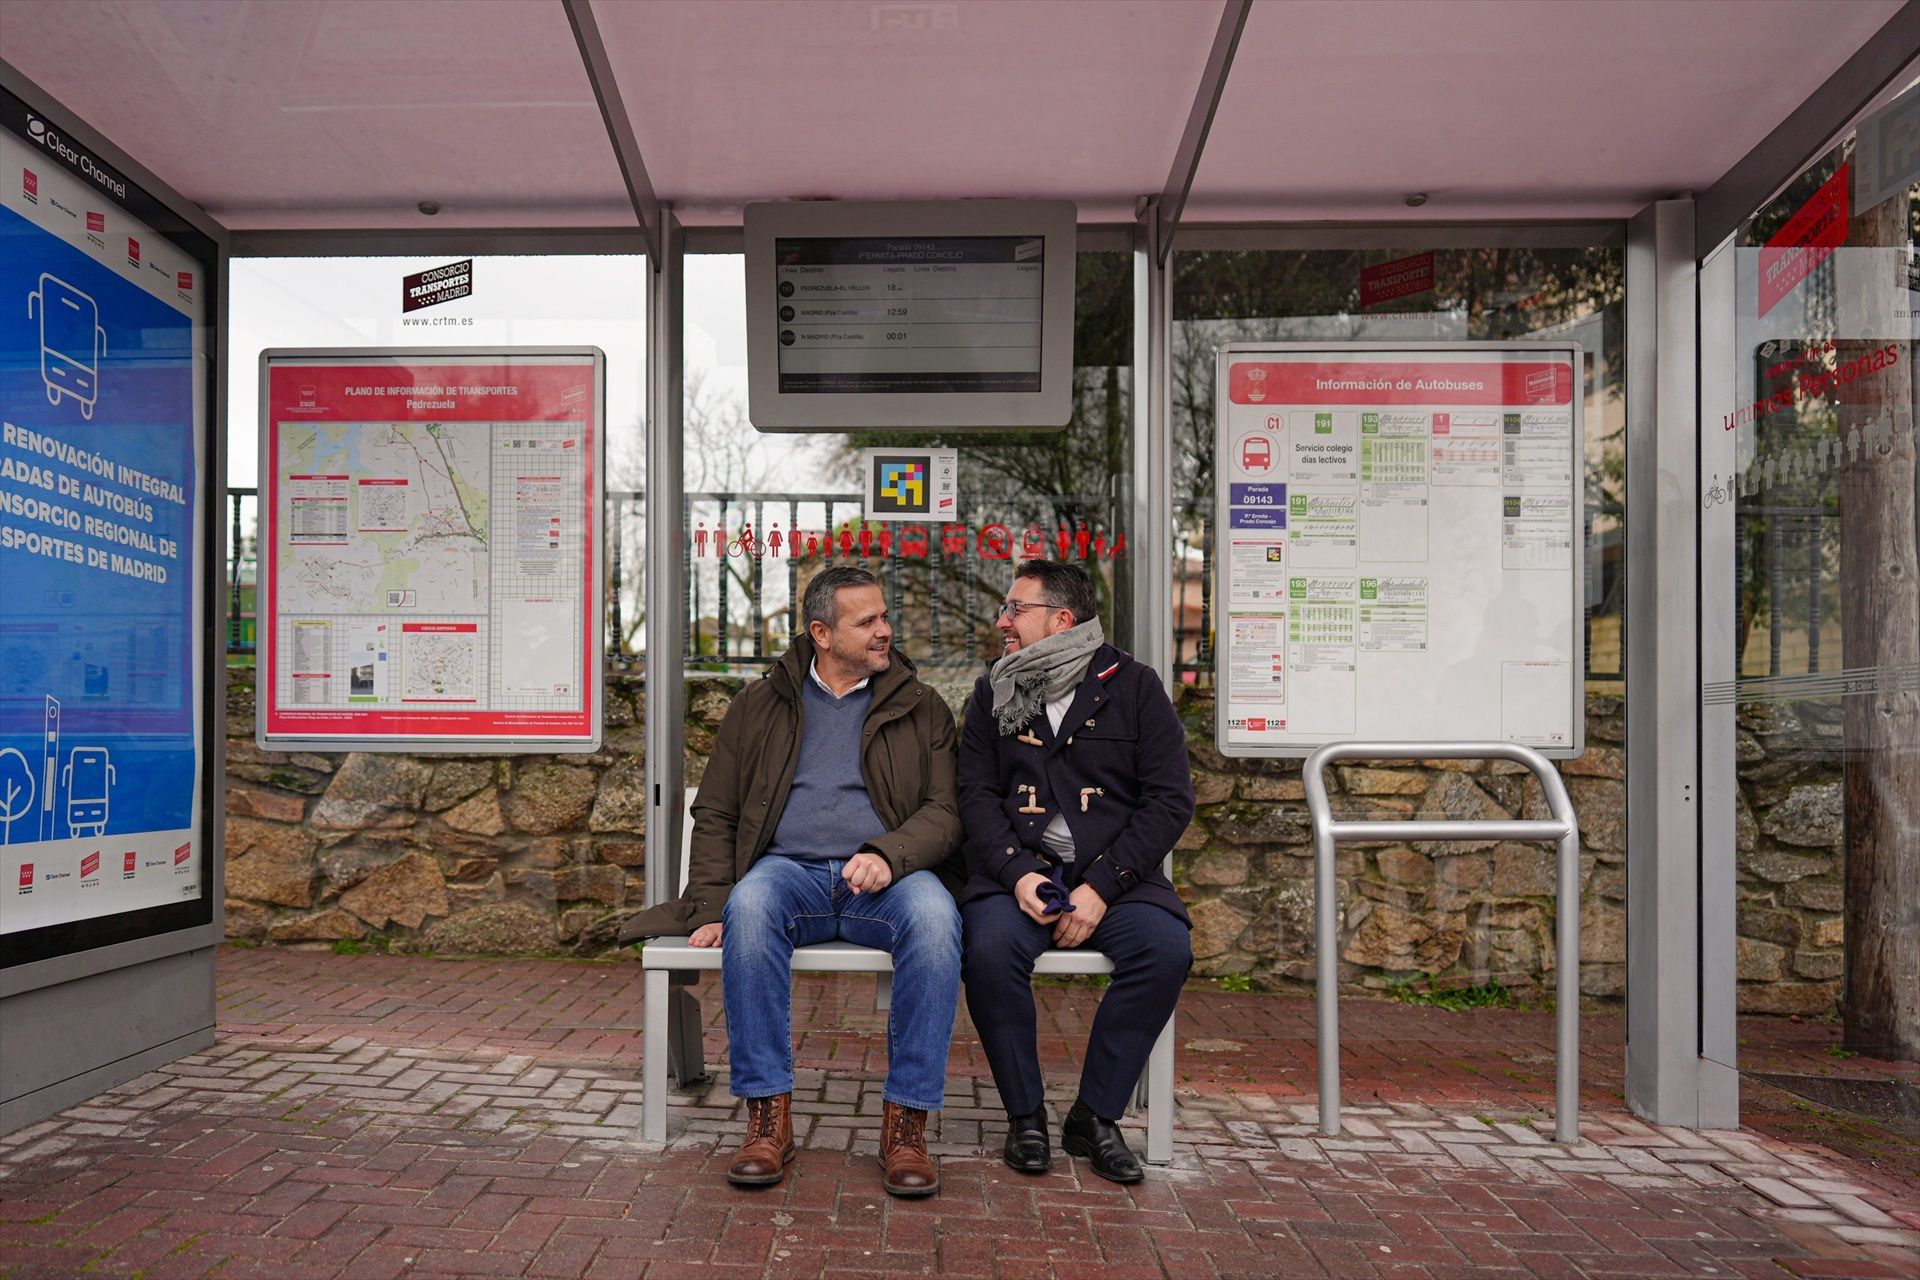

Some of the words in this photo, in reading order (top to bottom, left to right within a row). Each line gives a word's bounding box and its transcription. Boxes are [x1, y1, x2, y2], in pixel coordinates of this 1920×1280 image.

[47, 131, 78, 165] Clear
[80, 156, 126, 198] Channel
[422, 262, 469, 283] CONSORCIO
[410, 274, 469, 298] TRANSPORTES
[437, 285, 469, 302] MADRID
[402, 318, 474, 326] www.crtm.es
[886, 332, 907, 340] 00:01
[1316, 378, 1393, 390] Información
[1396, 379, 1412, 390] de
[1415, 379, 1484, 390] Autobuses
[1723, 387, 1794, 432] unimos
[1800, 343, 1898, 400] Personas
[345, 386, 372, 396] PLANO
[374, 386, 386, 396] DE
[387, 385, 444, 396] INFORMACIÓN
[446, 386, 457, 396] DE
[458, 386, 518, 395] TRANSPORTES
[406, 400, 456, 408] Pedrezuela
[1267, 417, 1280, 430] C1
[1316, 420, 1330, 428] 191
[1439, 414, 1443, 422] 1
[1296, 444, 1324, 452] Servicio
[1326, 444, 1352, 454] colegio
[3, 422, 115, 480] RENOVACIÓN
[118, 464, 186, 506] INTEGRAL
[1319, 456, 1346, 464] lectivos
[0, 458, 54, 490] ADAS
[58, 474, 80, 499] DE
[83, 484, 153, 522] AUTOBÚS
[1243, 496, 1273, 504] 09143
[84, 514, 157, 553] REGIONAL
[160, 538, 177, 558] DE
[0, 526, 84, 564] SPORTES
[88, 547, 108, 570] DE
[111, 553, 166, 584] MADRID
[1360, 580, 1376, 588] 196
